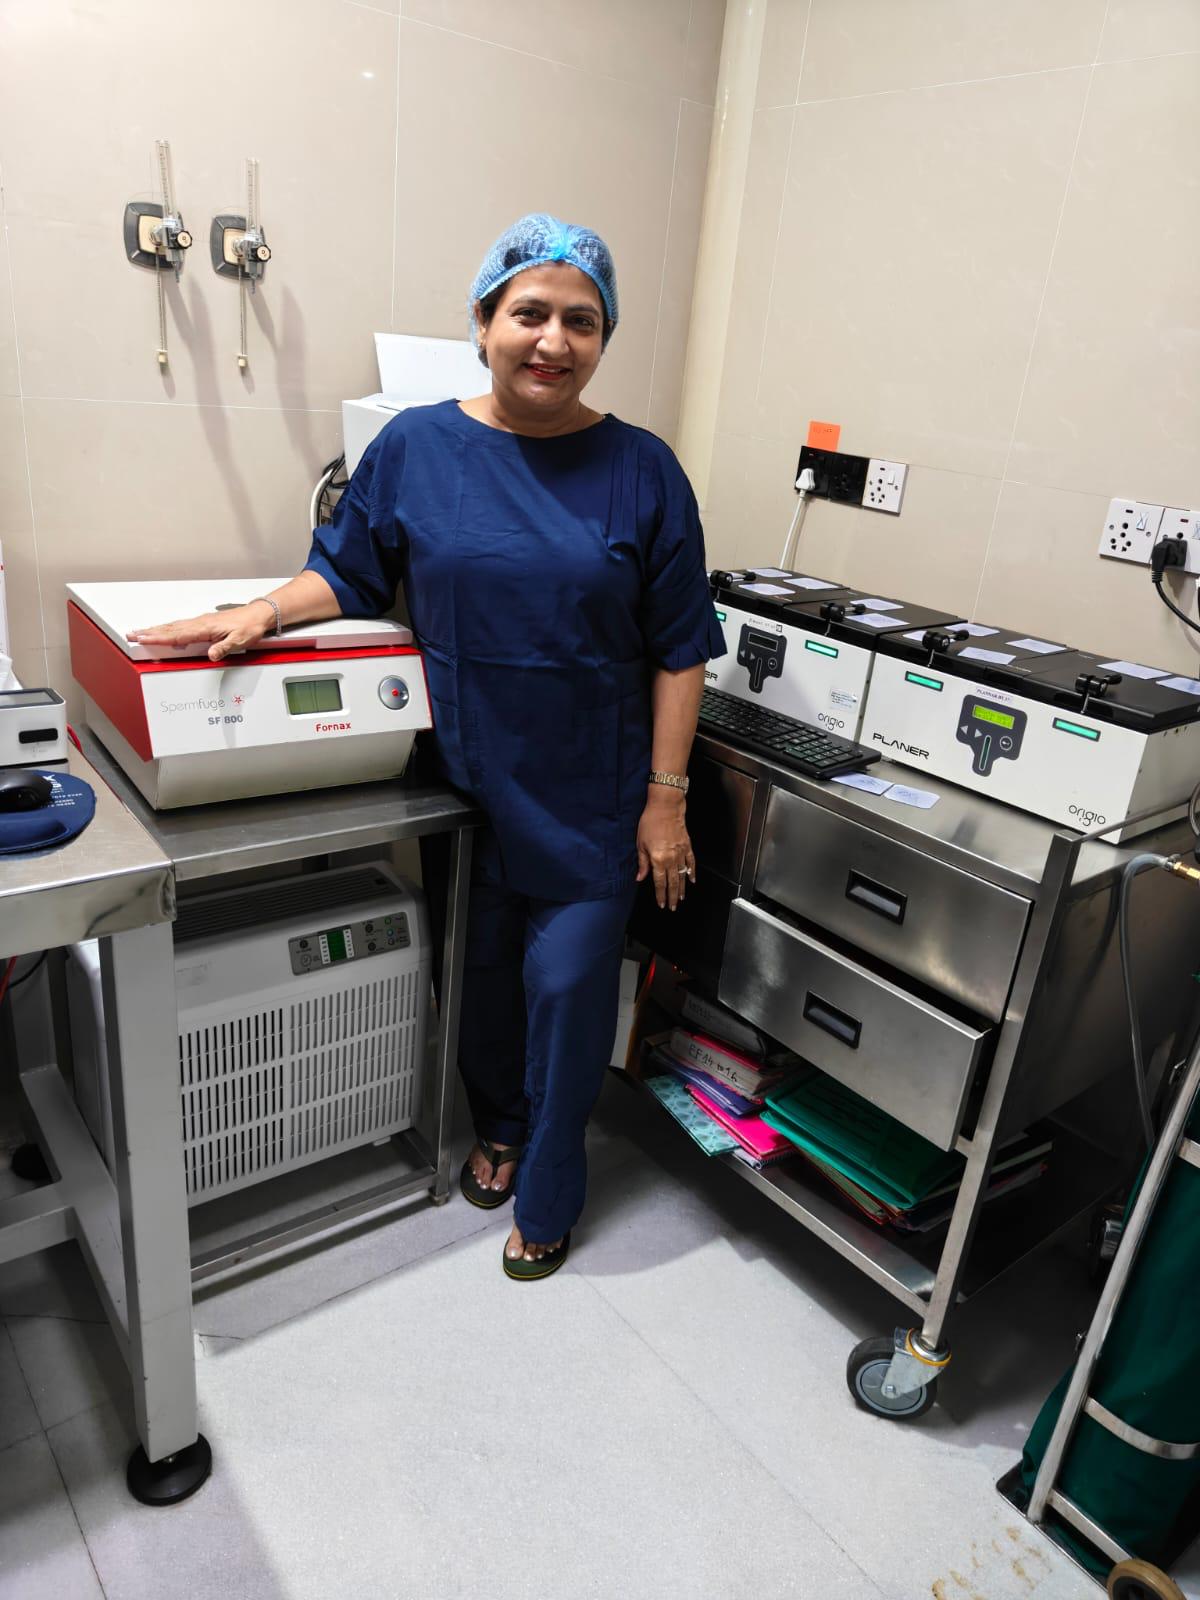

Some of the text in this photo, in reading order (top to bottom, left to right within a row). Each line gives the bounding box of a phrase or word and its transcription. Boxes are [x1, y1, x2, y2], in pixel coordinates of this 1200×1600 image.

[159, 698, 226, 715] Spermfuge
[207, 714, 244, 726] SF 800
[315, 722, 352, 733] Fornax
[817, 712, 845, 731] origio
[872, 732, 930, 760] PLANER
[1068, 804, 1106, 827] origio
